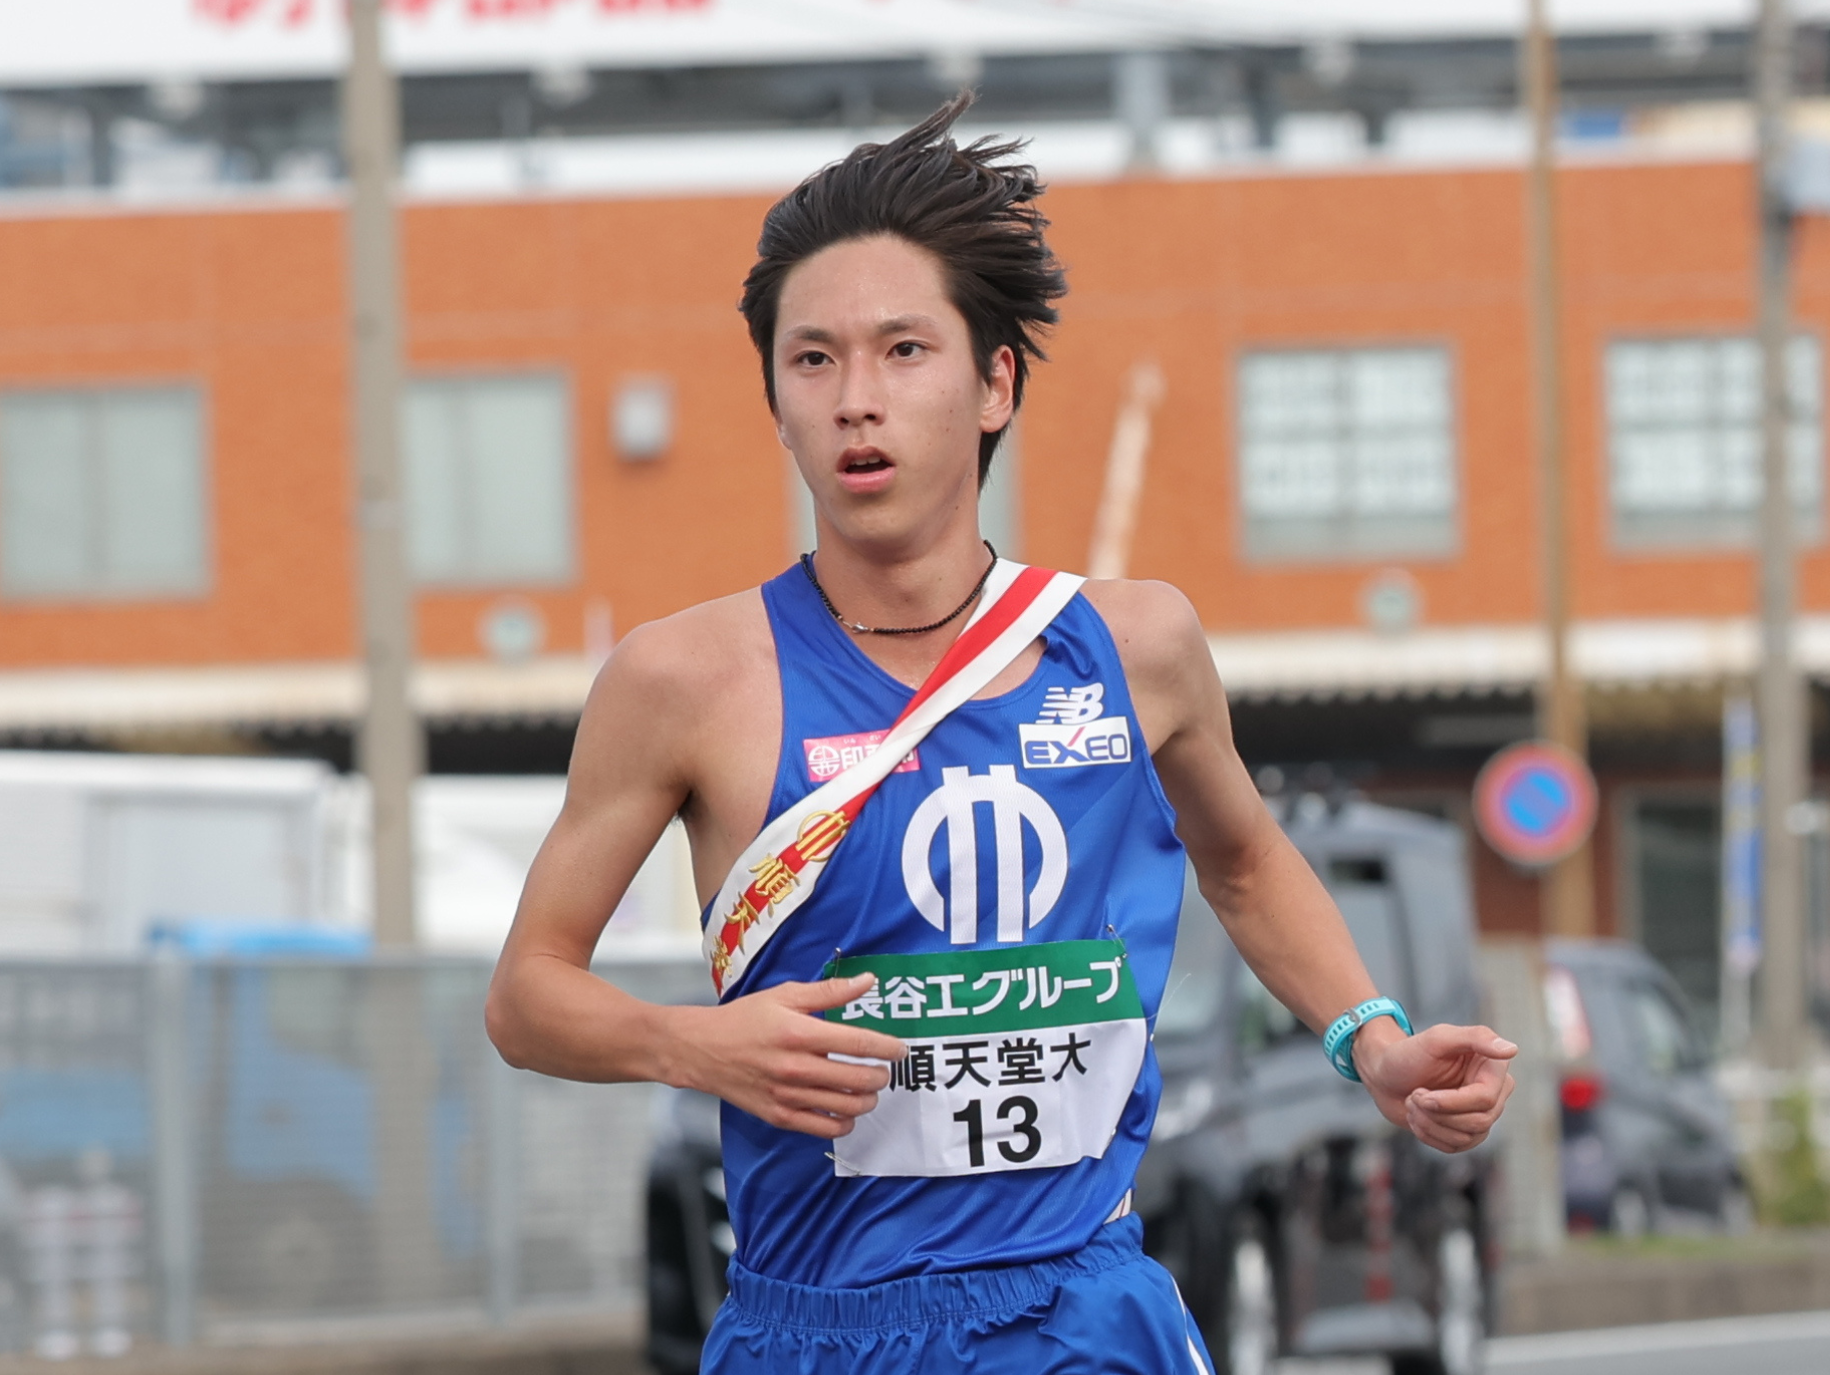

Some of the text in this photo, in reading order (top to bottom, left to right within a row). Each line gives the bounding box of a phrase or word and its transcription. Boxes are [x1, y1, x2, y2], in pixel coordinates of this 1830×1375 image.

[1025, 726, 1128, 764] EXEO
[889, 1032, 1092, 1092] 順天堂大
[953, 1096, 1041, 1167] 13
